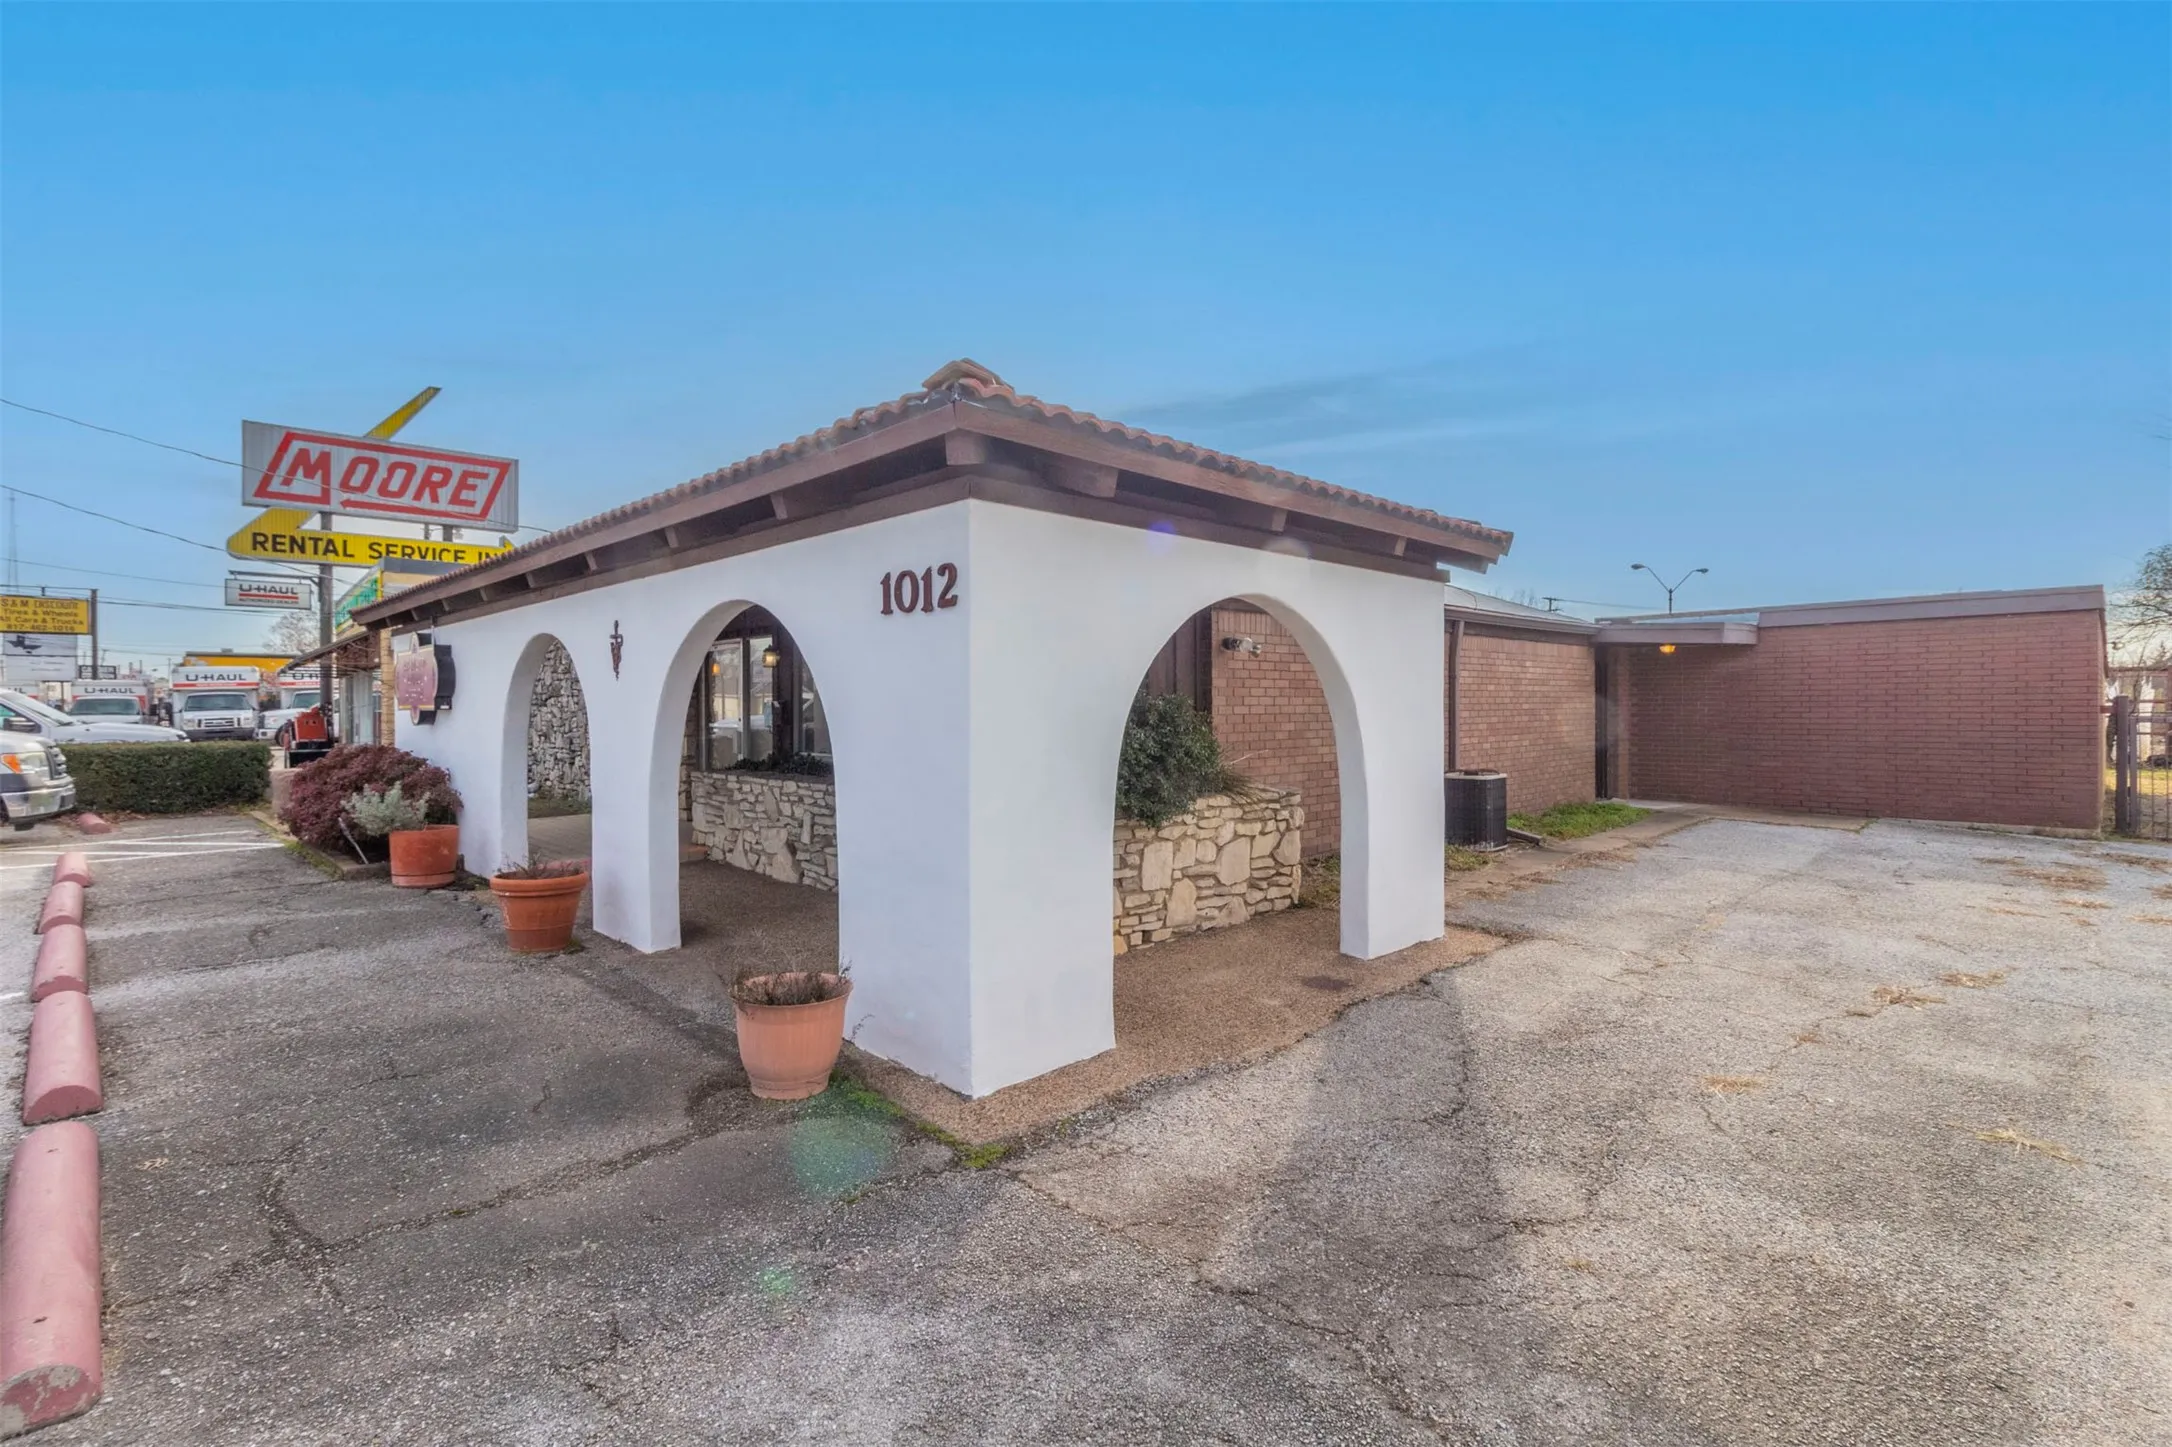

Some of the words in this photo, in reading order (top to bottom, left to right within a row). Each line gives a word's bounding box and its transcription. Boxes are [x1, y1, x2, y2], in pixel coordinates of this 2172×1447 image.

[280, 447, 489, 508] MOORE
[252, 532, 355, 558] RENTAL
[368, 542, 465, 561] SERVICE
[239, 583, 298, 595] U-HAUL
[880, 562, 958, 615] 1012
[185, 673, 246, 682] U-HAUL
